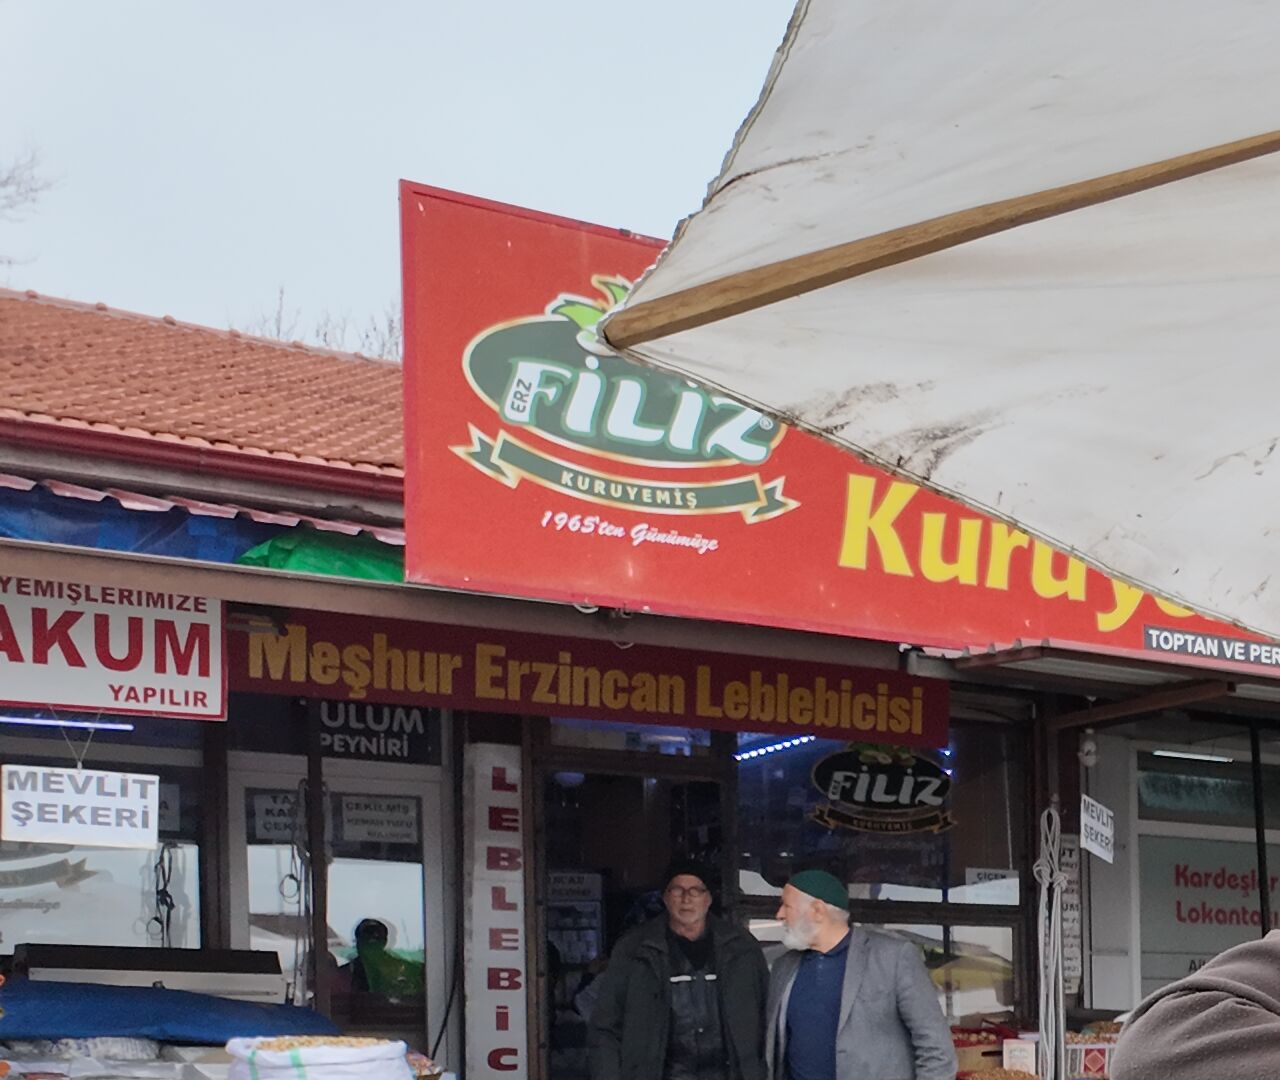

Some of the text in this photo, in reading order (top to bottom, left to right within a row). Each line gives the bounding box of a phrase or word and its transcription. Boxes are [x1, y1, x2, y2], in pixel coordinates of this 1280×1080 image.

[505, 356, 770, 462] FİLİZ
[510, 378, 533, 413] ERZ
[560, 470, 698, 509] KURUYEMİŞ
[630, 522, 719, 554] Günümüze
[838, 473, 1202, 632] Kuruy
[1148, 629, 1218, 657] TOPTAN
[1222, 640, 1246, 661] VE
[108, 684, 208, 708] YAPILIR
[249, 623, 923, 735] Meşhur Erzincan Leblebicisi
[7, 769, 156, 800] MEVLİT
[828, 765, 944, 806] FİLİZ
[11, 801, 149, 829] ŞEKERİ
[1174, 864, 1280, 898] Kardeşlr
[1175, 898, 1280, 927] Lokantaı
